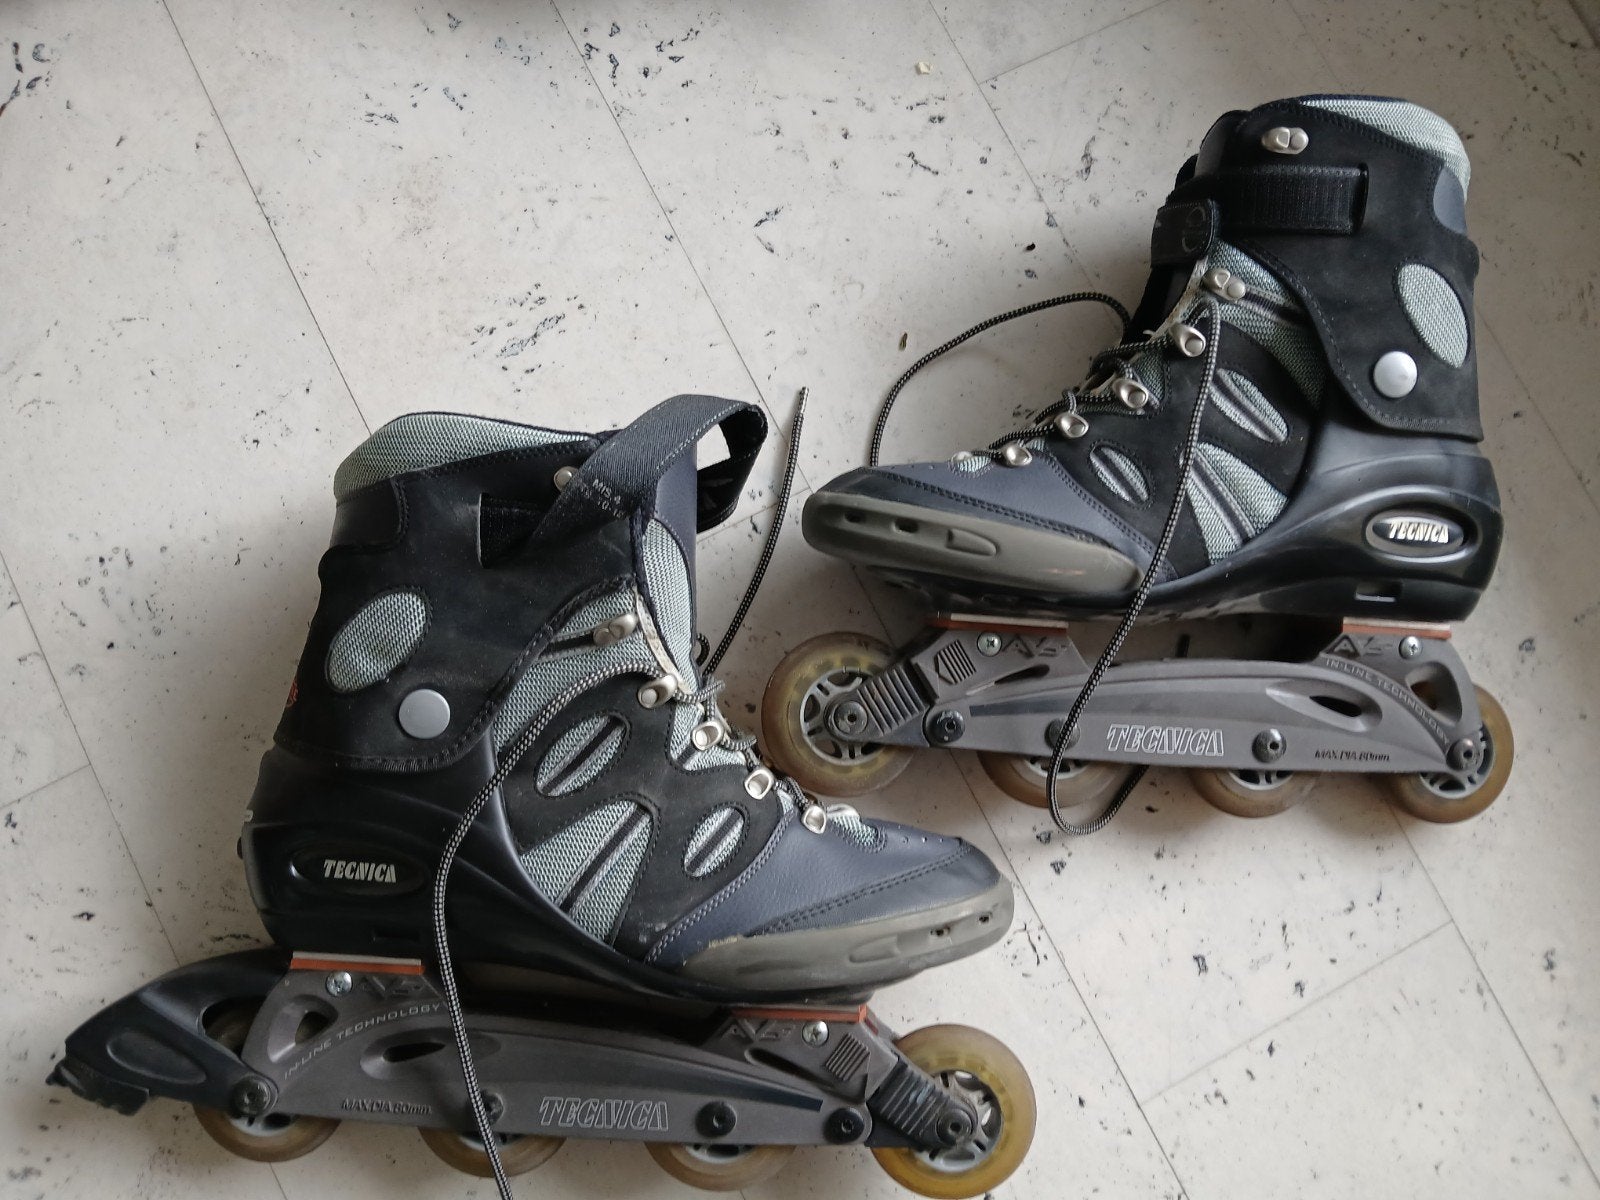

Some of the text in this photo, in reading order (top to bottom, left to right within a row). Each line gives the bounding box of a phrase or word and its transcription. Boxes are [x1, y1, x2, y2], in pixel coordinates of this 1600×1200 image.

[1389, 521, 1449, 544] TECNICA
[1377, 678, 1450, 744] TECHNOLOGY
[1107, 724, 1225, 756] TECNICA
[323, 859, 397, 883] TECNICA
[336, 1003, 441, 1040] TECHNOLOGY
[539, 1096, 669, 1131] TECNICA
